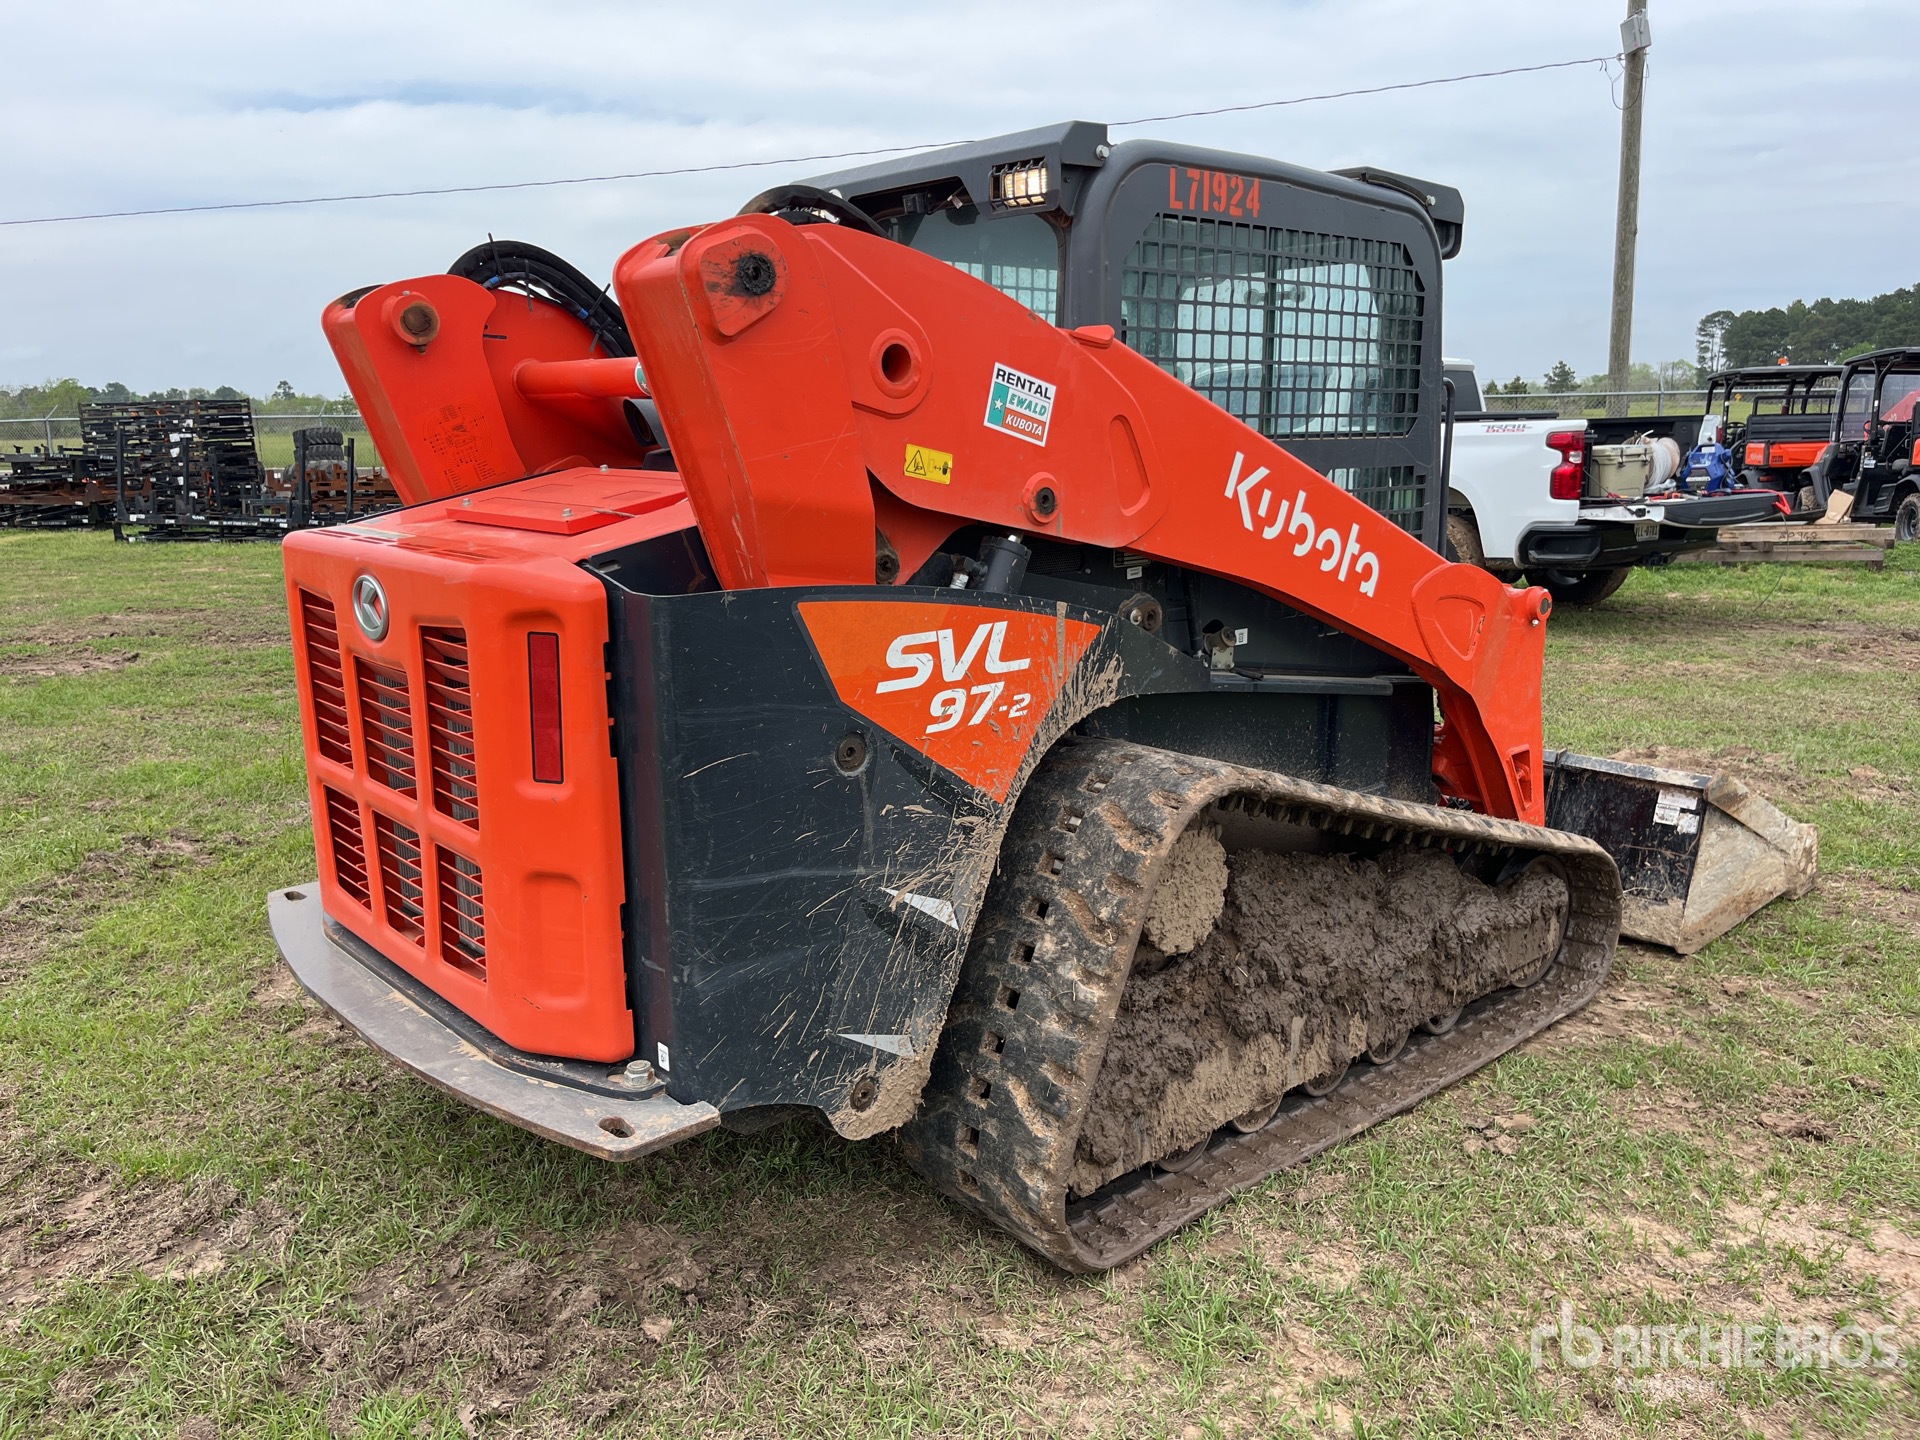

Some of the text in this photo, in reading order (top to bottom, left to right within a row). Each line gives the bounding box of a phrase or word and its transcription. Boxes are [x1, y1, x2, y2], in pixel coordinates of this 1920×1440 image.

[1169, 167, 1260, 218] L71924
[995, 367, 1051, 400] RENTAL
[1009, 393, 1047, 416] EWALD
[1005, 413, 1042, 436] KUBOTA
[1224, 450, 1379, 598] Kubota
[876, 621, 1031, 694] SVL
[925, 681, 1031, 734] 97-2
